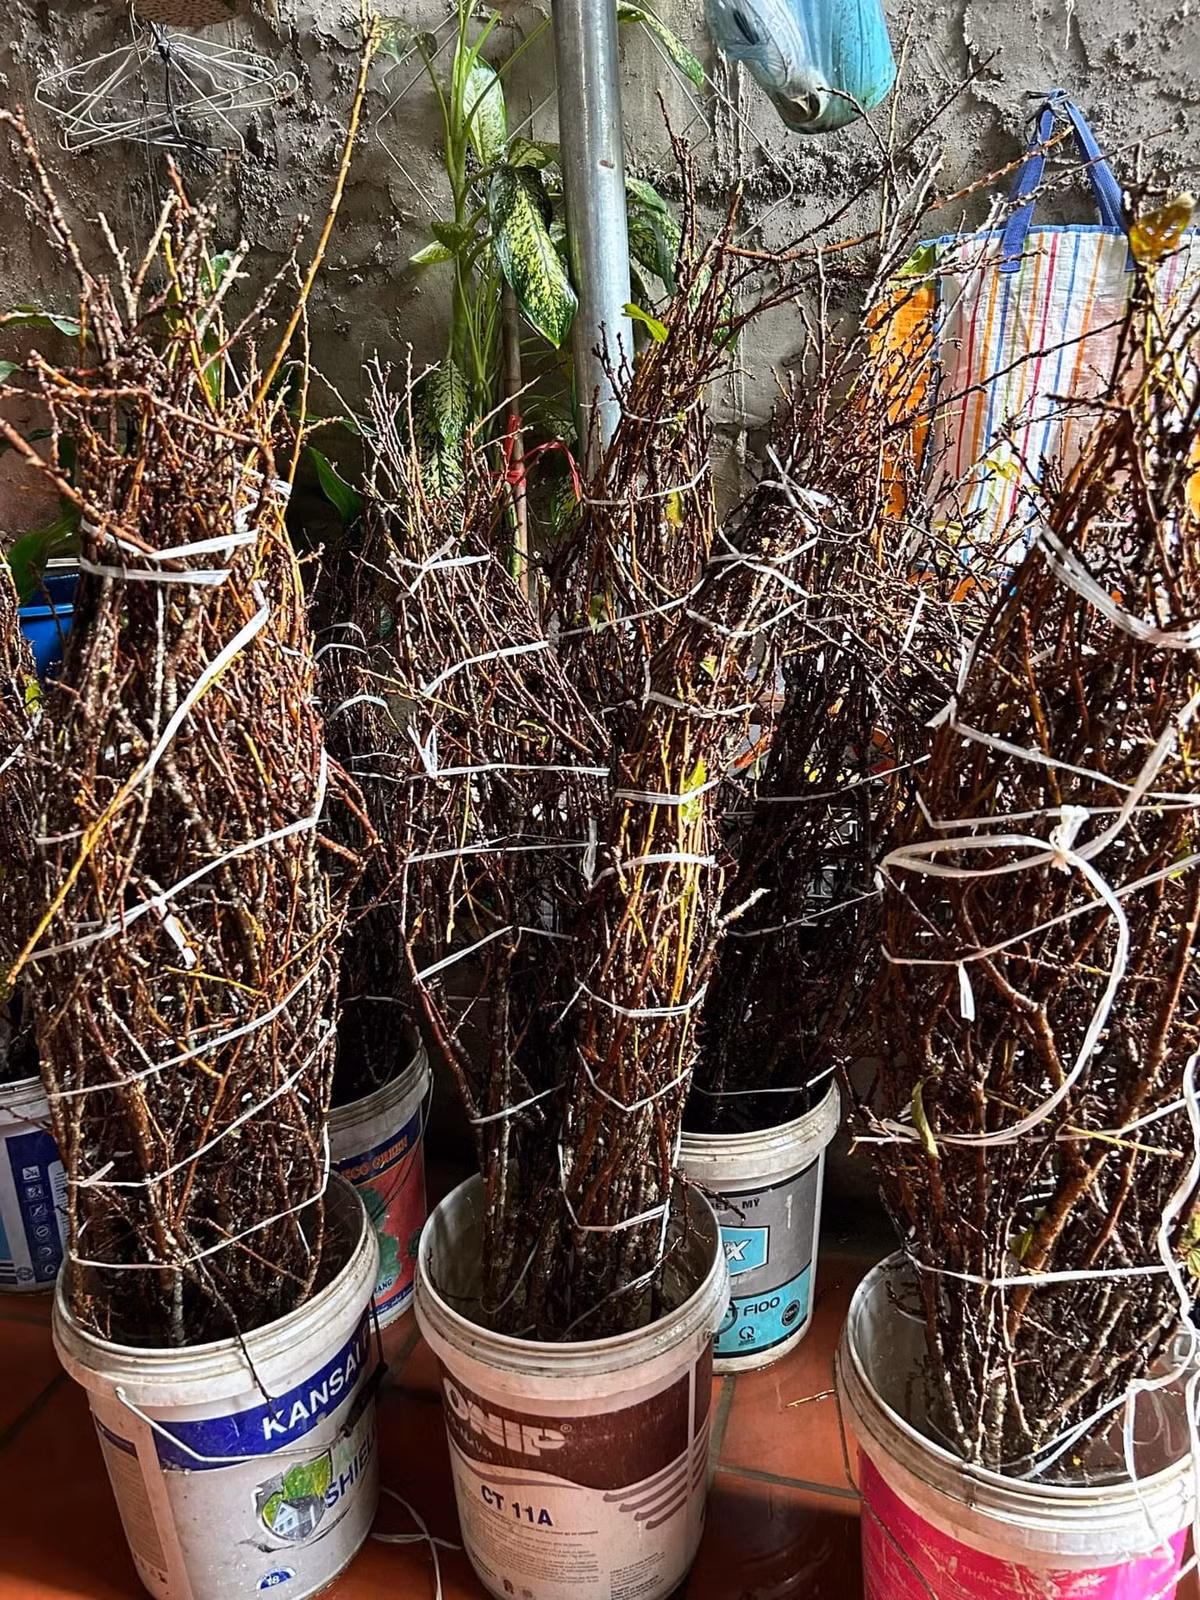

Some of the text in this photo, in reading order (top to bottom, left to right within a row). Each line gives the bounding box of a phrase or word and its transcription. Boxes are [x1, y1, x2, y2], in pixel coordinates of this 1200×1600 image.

[262, 1341, 360, 1440] KANSAI
[481, 1485, 553, 1527] CT 11A
